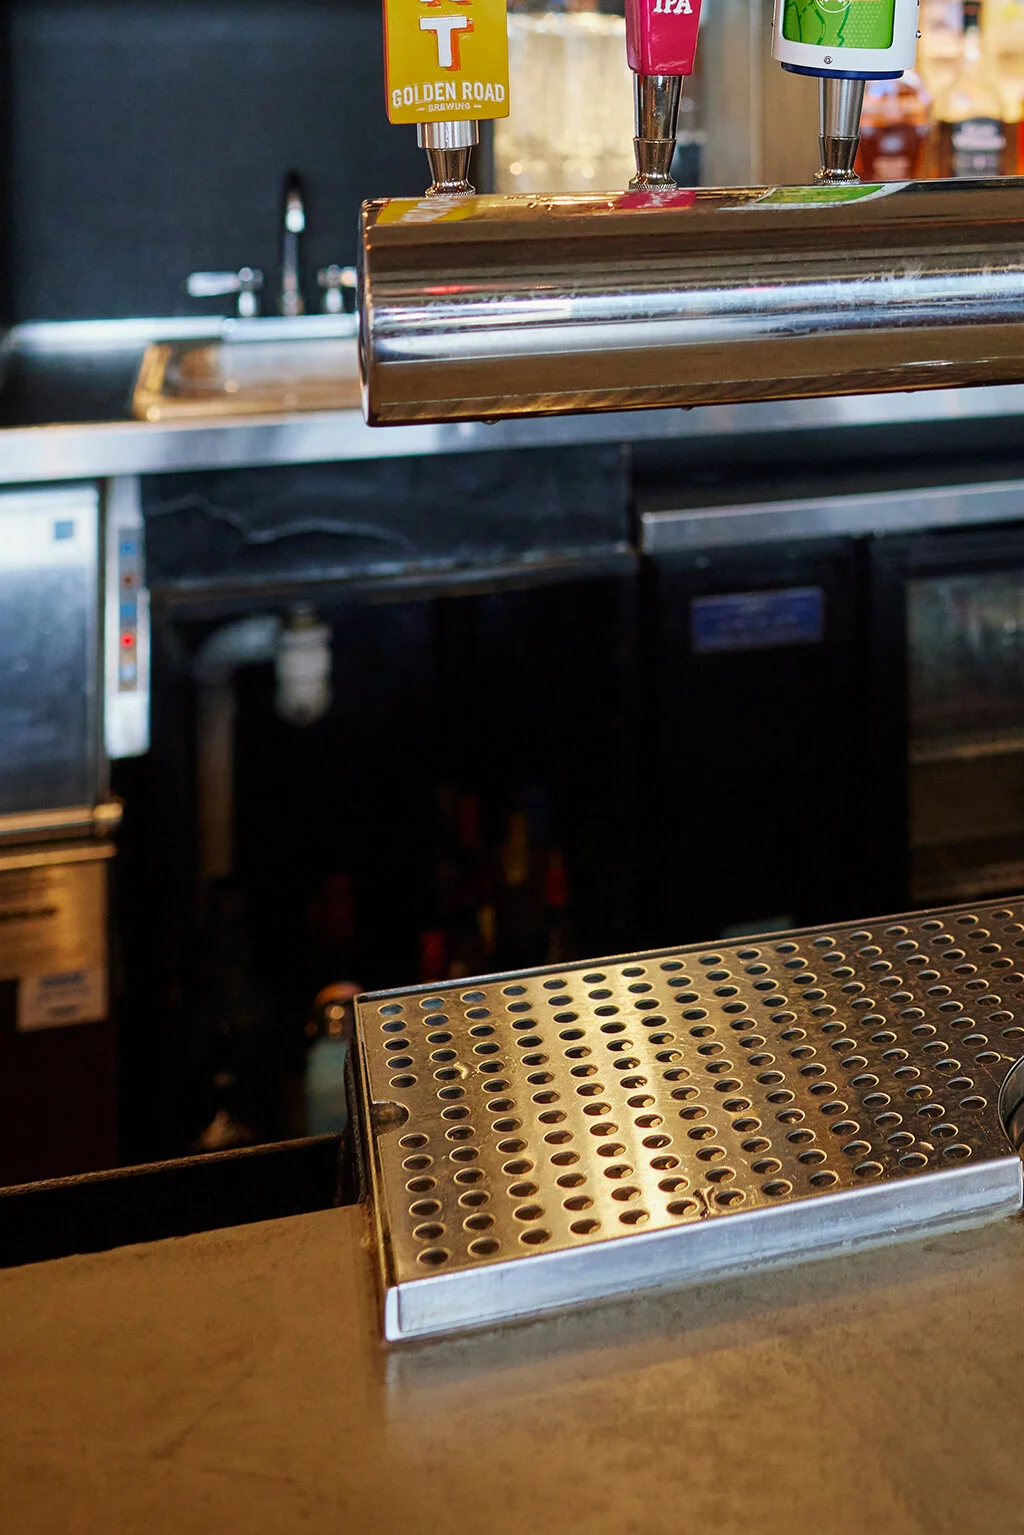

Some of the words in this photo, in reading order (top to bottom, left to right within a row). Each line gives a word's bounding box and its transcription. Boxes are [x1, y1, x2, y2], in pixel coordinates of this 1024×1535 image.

[391, 82, 457, 109] GOLDEN
[462, 81, 505, 103] ROAD
[428, 102, 471, 112] BREWING
